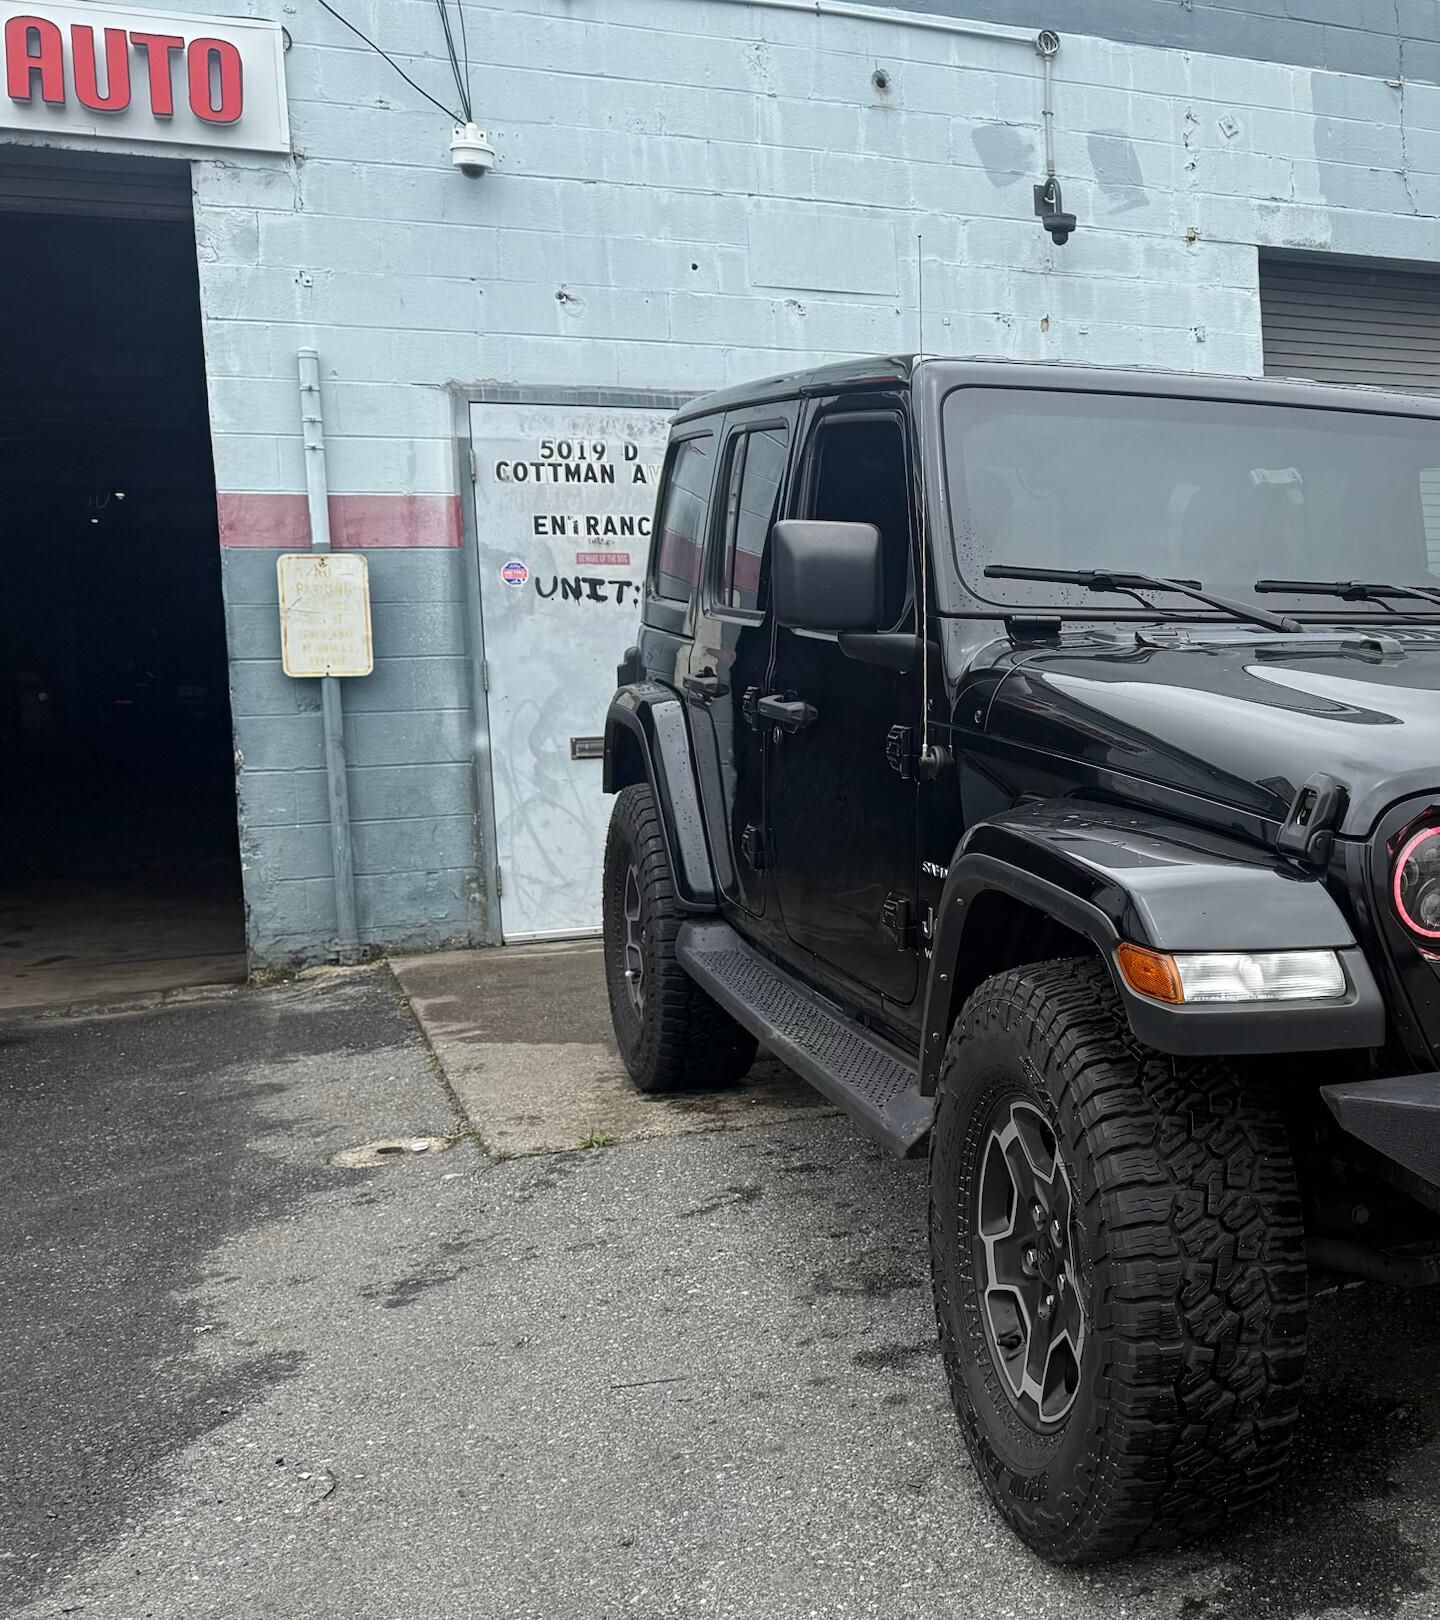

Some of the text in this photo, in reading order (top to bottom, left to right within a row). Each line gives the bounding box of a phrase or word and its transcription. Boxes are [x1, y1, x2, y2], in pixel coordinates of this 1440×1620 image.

[4, 15, 243, 125] AUTO
[540, 440, 638, 461] 5019 D
[495, 461, 615, 484] COTTMAN
